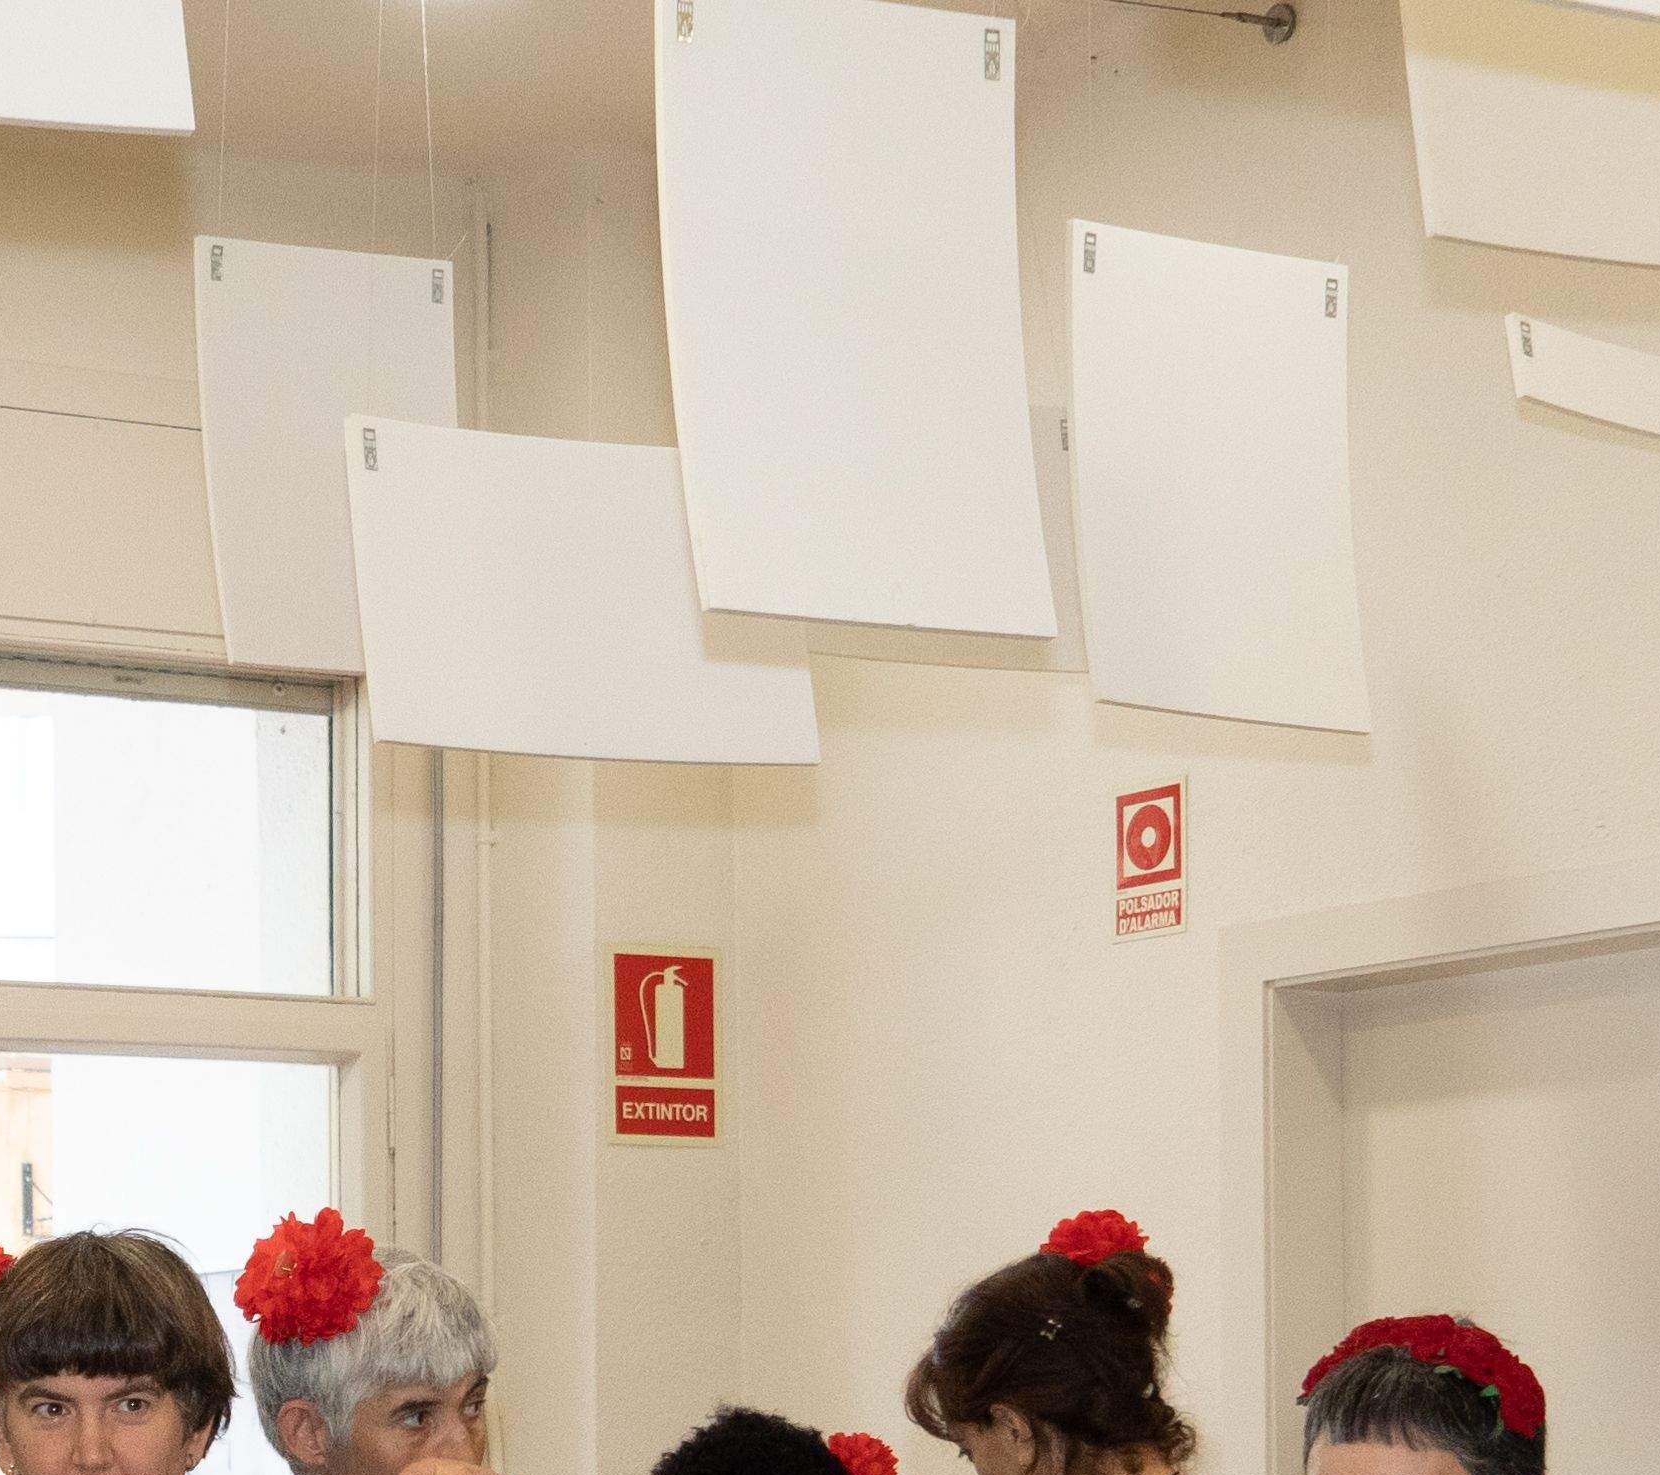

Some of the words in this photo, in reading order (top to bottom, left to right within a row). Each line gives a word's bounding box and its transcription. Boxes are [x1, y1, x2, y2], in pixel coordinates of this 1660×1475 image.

[1119, 892, 1179, 917] POLSADOR
[1119, 911, 1177, 935] D'ALARMA
[622, 1101, 708, 1123] EXTINTOR
